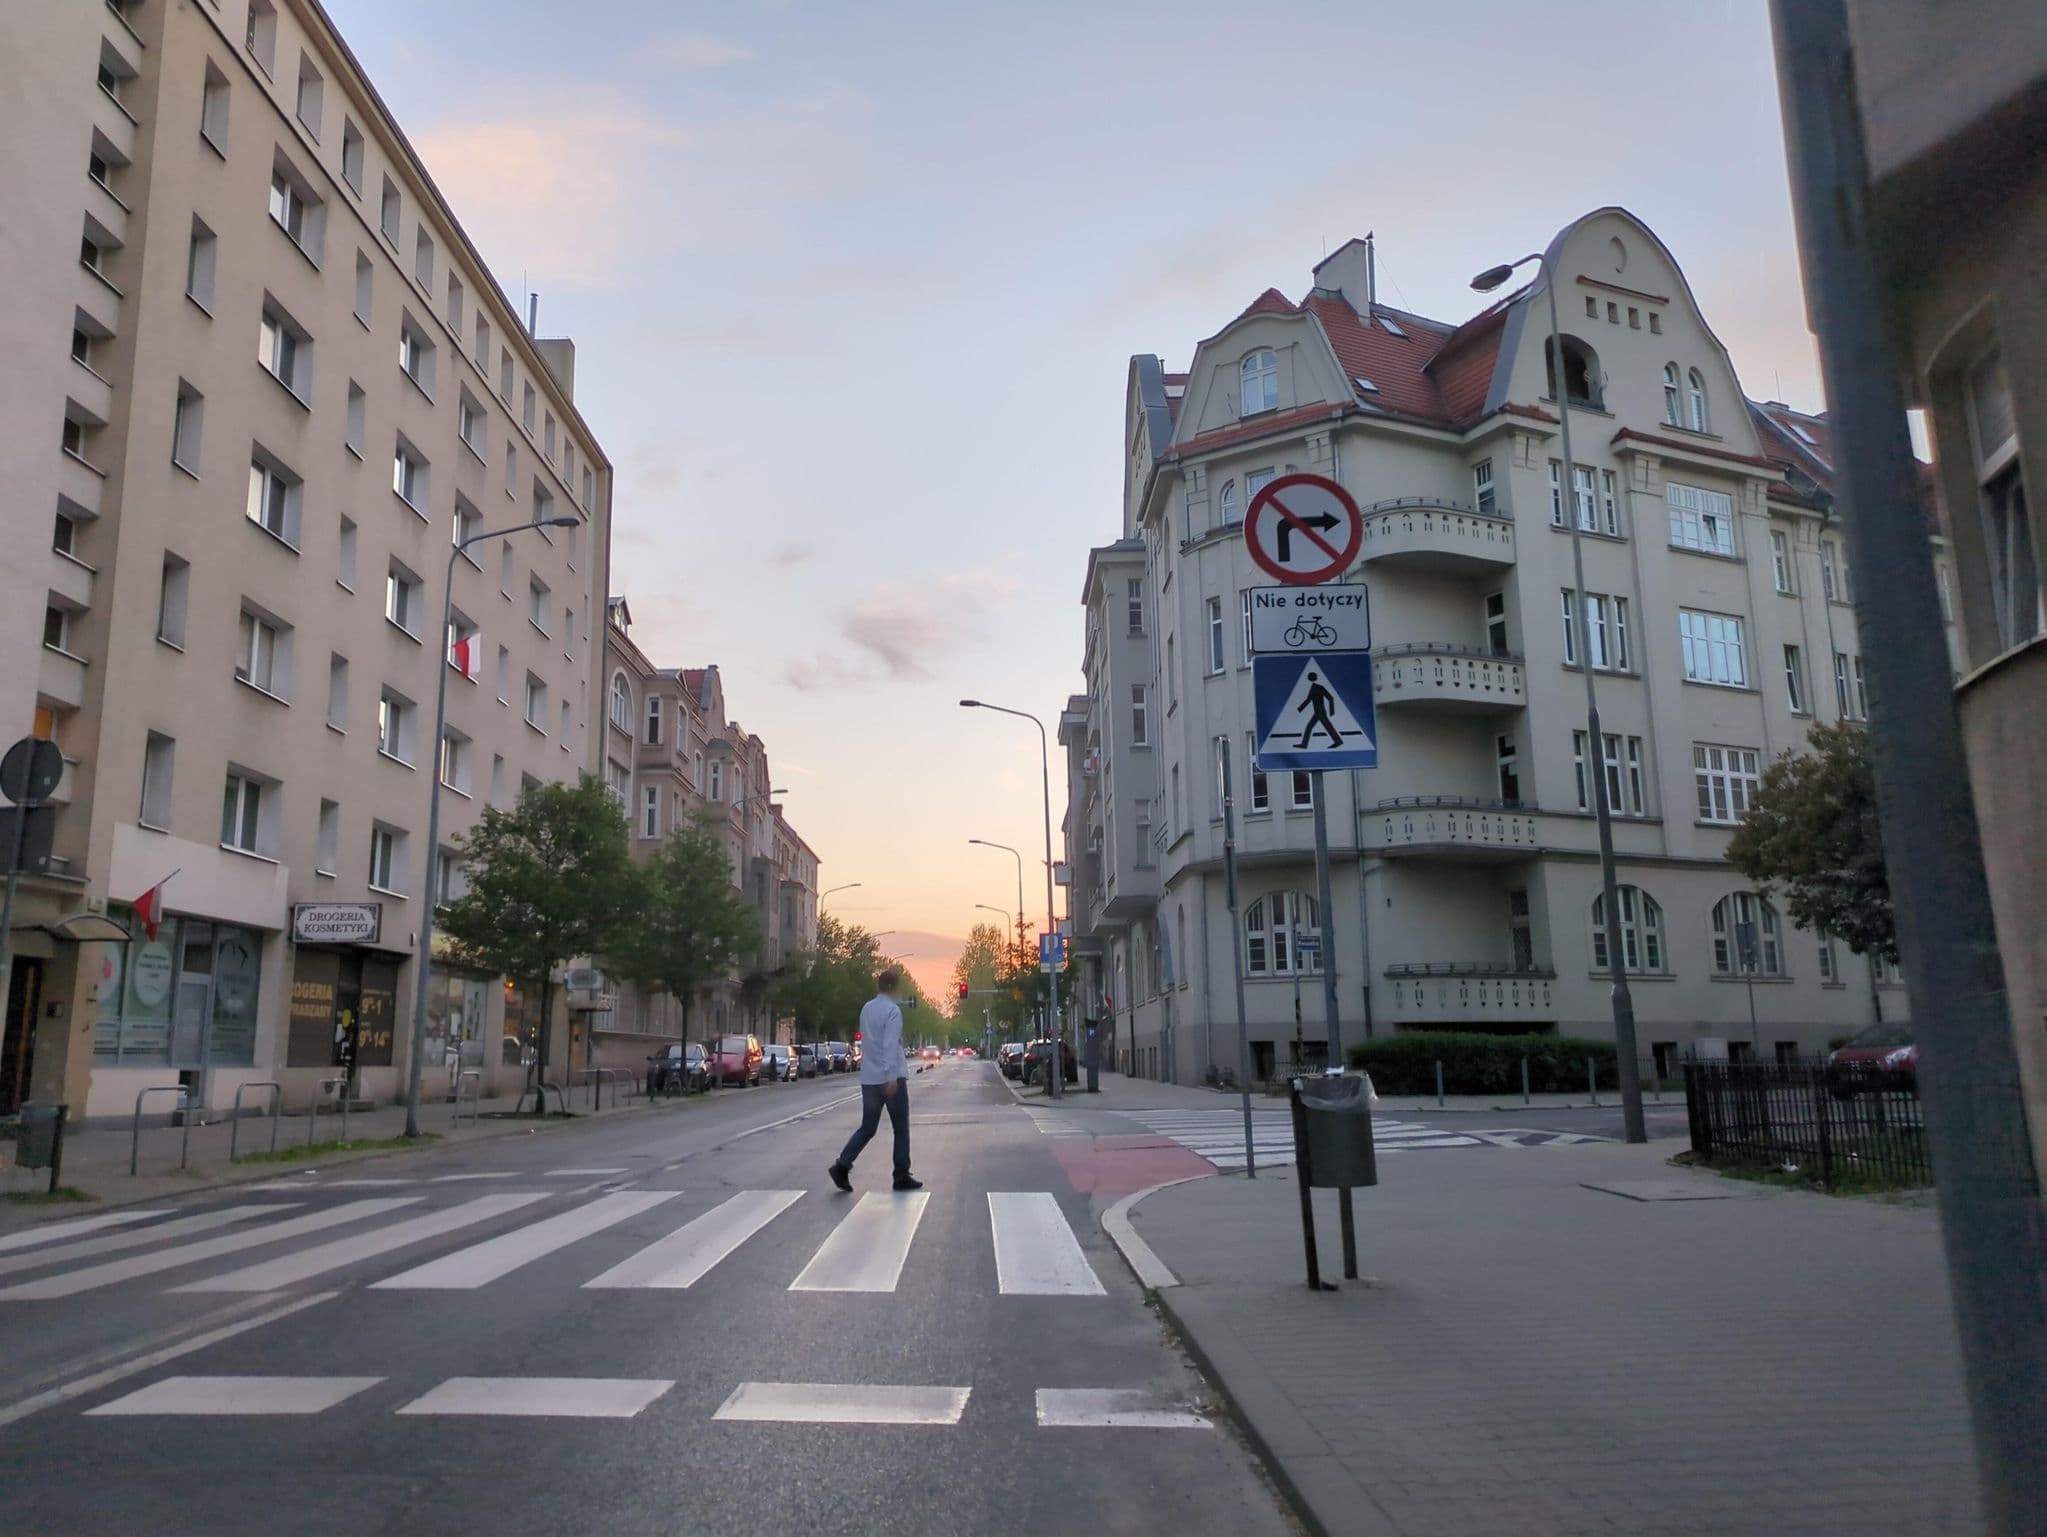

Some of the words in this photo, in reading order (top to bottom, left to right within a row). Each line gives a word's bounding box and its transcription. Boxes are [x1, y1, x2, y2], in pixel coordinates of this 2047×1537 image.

[1256, 593, 1287, 608] Nie
[1294, 591, 1363, 610] dotyczy
[309, 912, 366, 921] DROGERIA
[303, 923, 368, 933] KOSMETYKI
[291, 982, 333, 1000] OGERIA
